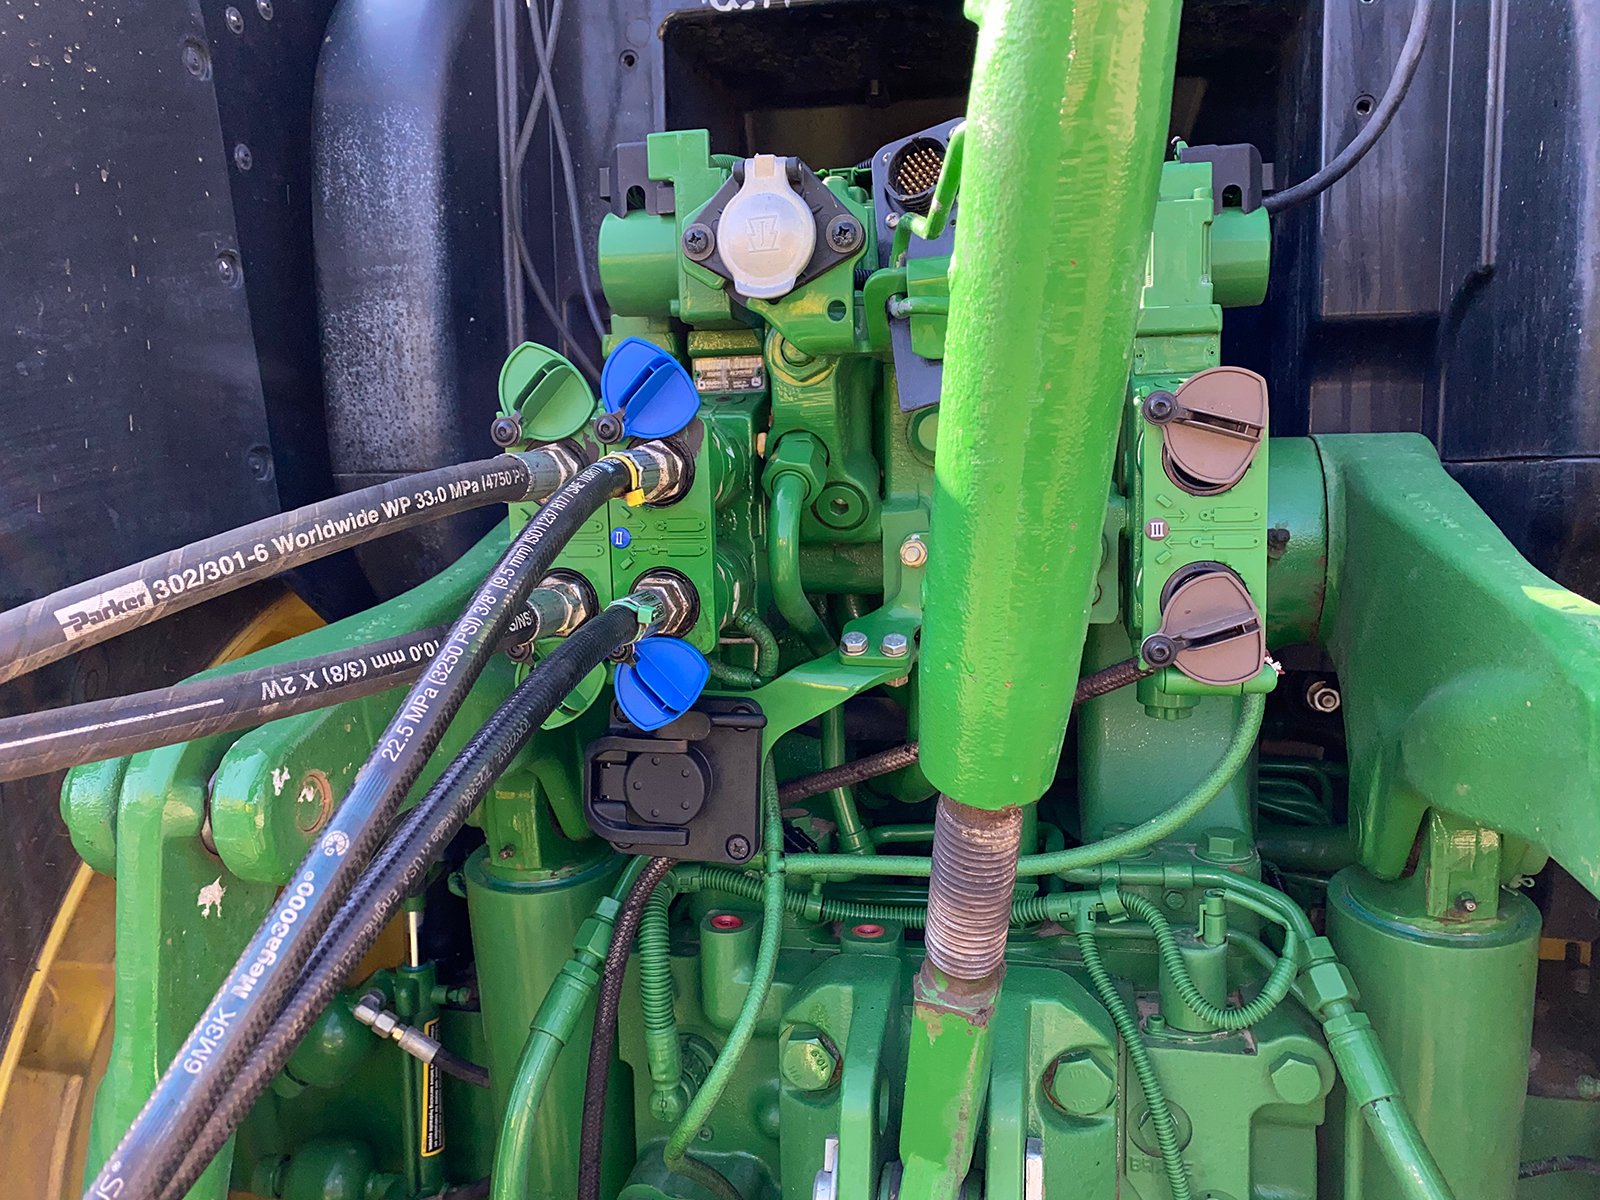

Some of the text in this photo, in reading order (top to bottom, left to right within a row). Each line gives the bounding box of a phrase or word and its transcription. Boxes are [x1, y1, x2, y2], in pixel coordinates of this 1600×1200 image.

[60, 590, 148, 634] Parker
[153, 543, 269, 600] 302/301-6
[273, 509, 380, 555] Worldwide
[381, 496, 412, 519] WP
[415, 486, 447, 509] 33,0
[449, 479, 479, 500] MPa
[381, 724, 414, 762] 22.5
[404, 688, 439, 724] MPa
[427, 645, 464, 686] (3250
[455, 616, 484, 645] PSI)
[492, 567, 516, 590] (9.5
[509, 544, 534, 568] mm)
[550, 495, 568, 511] R17
[565, 480, 586, 495] SAE
[324, 659, 368, 685] (3/8)
[370, 648, 406, 669] mm
[261, 677, 298, 701] 2W
[299, 671, 319, 691] X
[401, 856, 426, 886] USA
[183, 1007, 237, 1075] 6M3K
